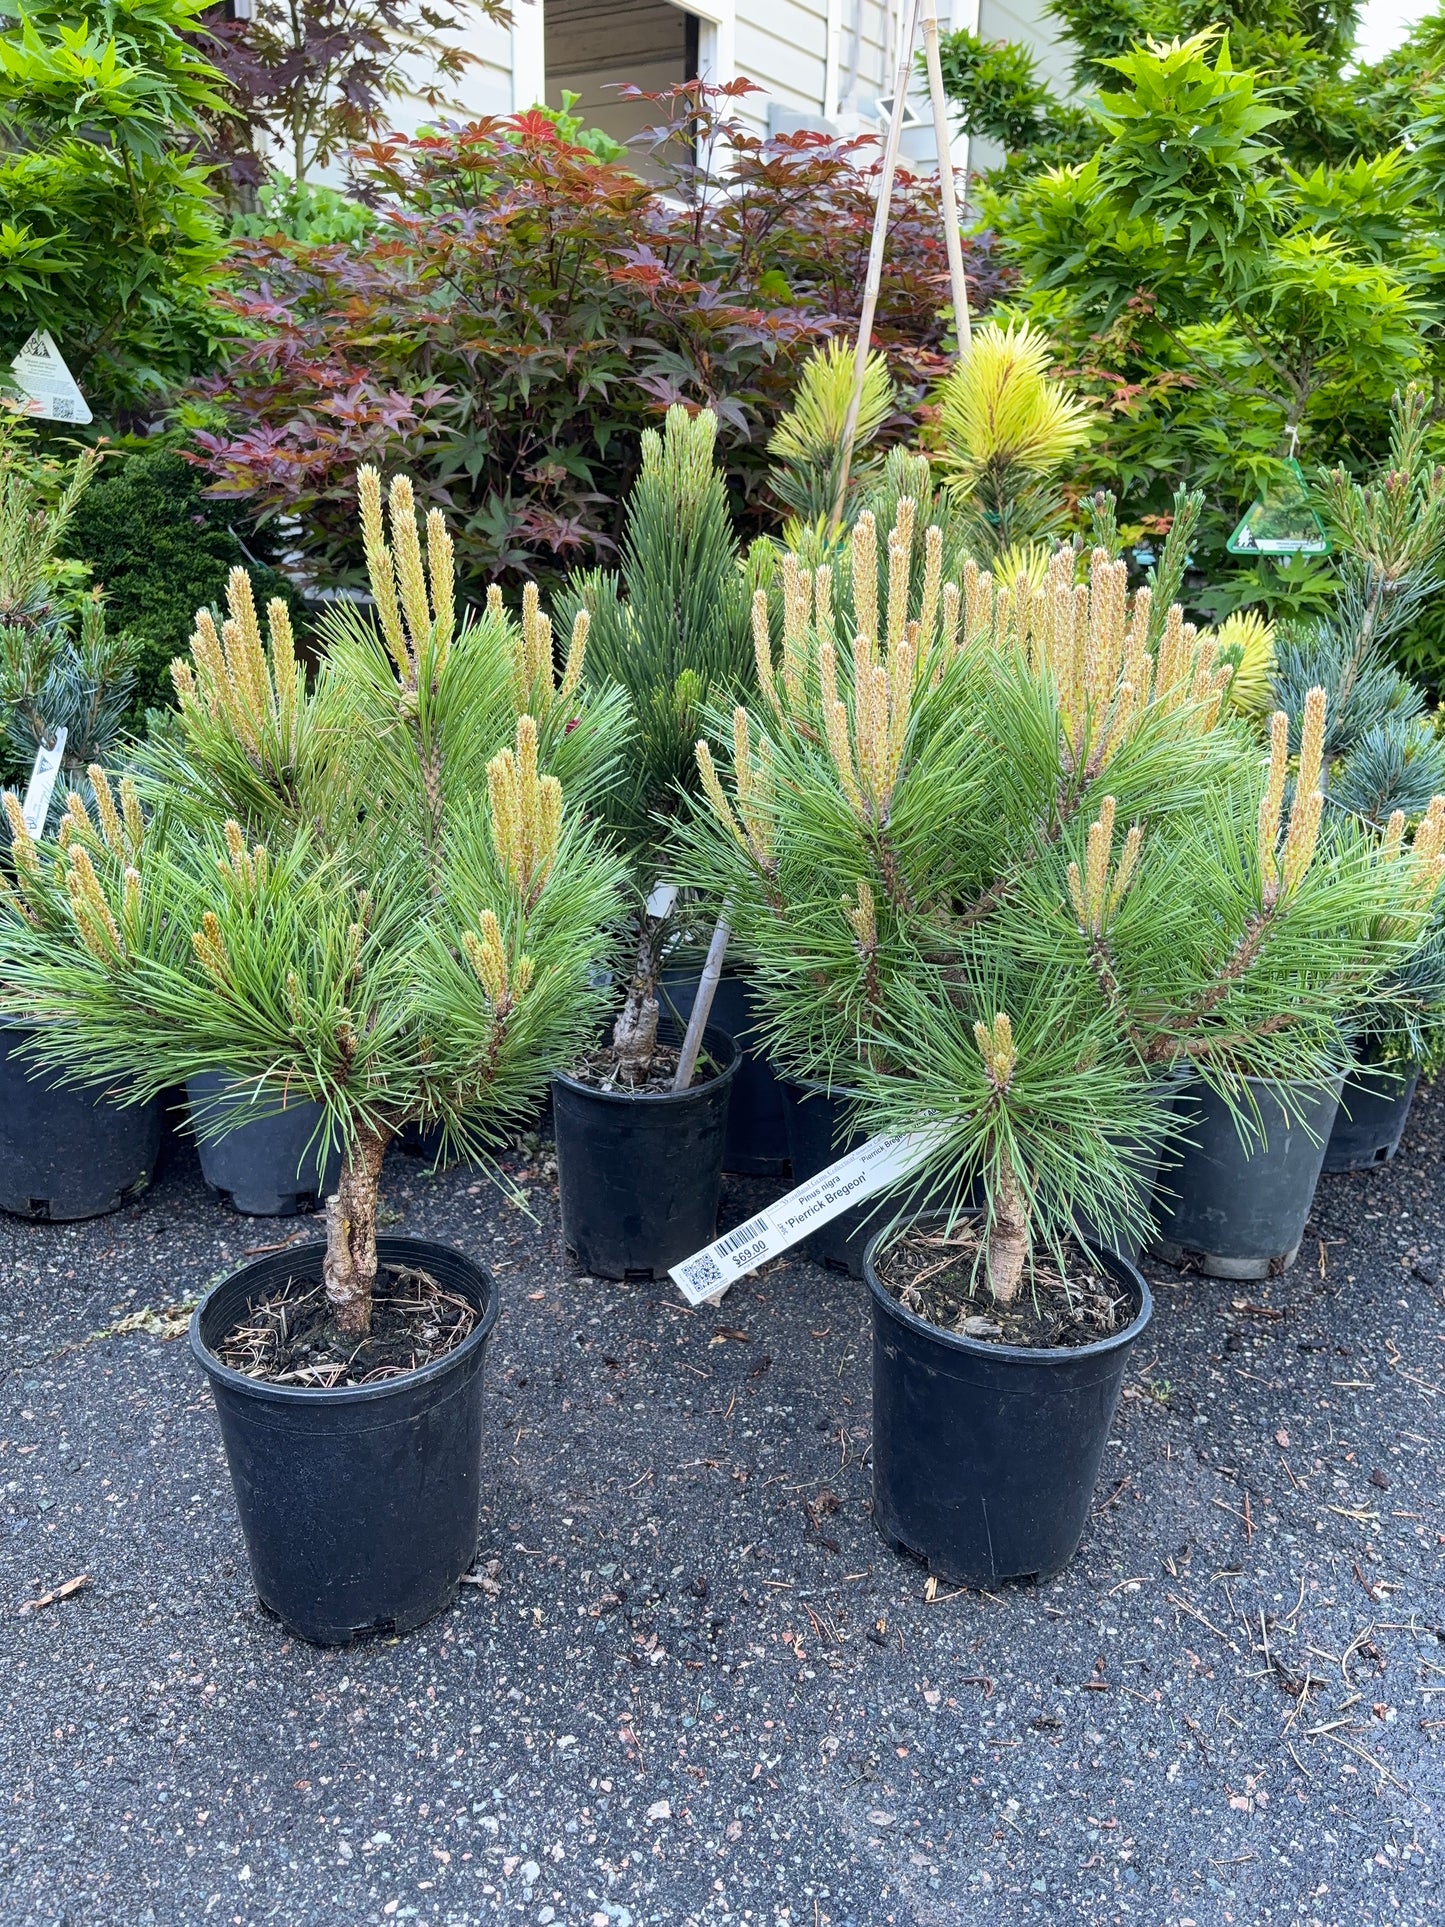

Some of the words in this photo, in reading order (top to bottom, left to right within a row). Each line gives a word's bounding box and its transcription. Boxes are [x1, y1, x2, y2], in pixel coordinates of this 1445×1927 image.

[784, 1198, 825, 1228] 'Pierrick
[824, 1171, 866, 1203] Bregeon'
[798, 1187, 821, 1205] Pinus
[820, 1175, 840, 1190] nigra
[731, 1238, 767, 1266] $69.00
